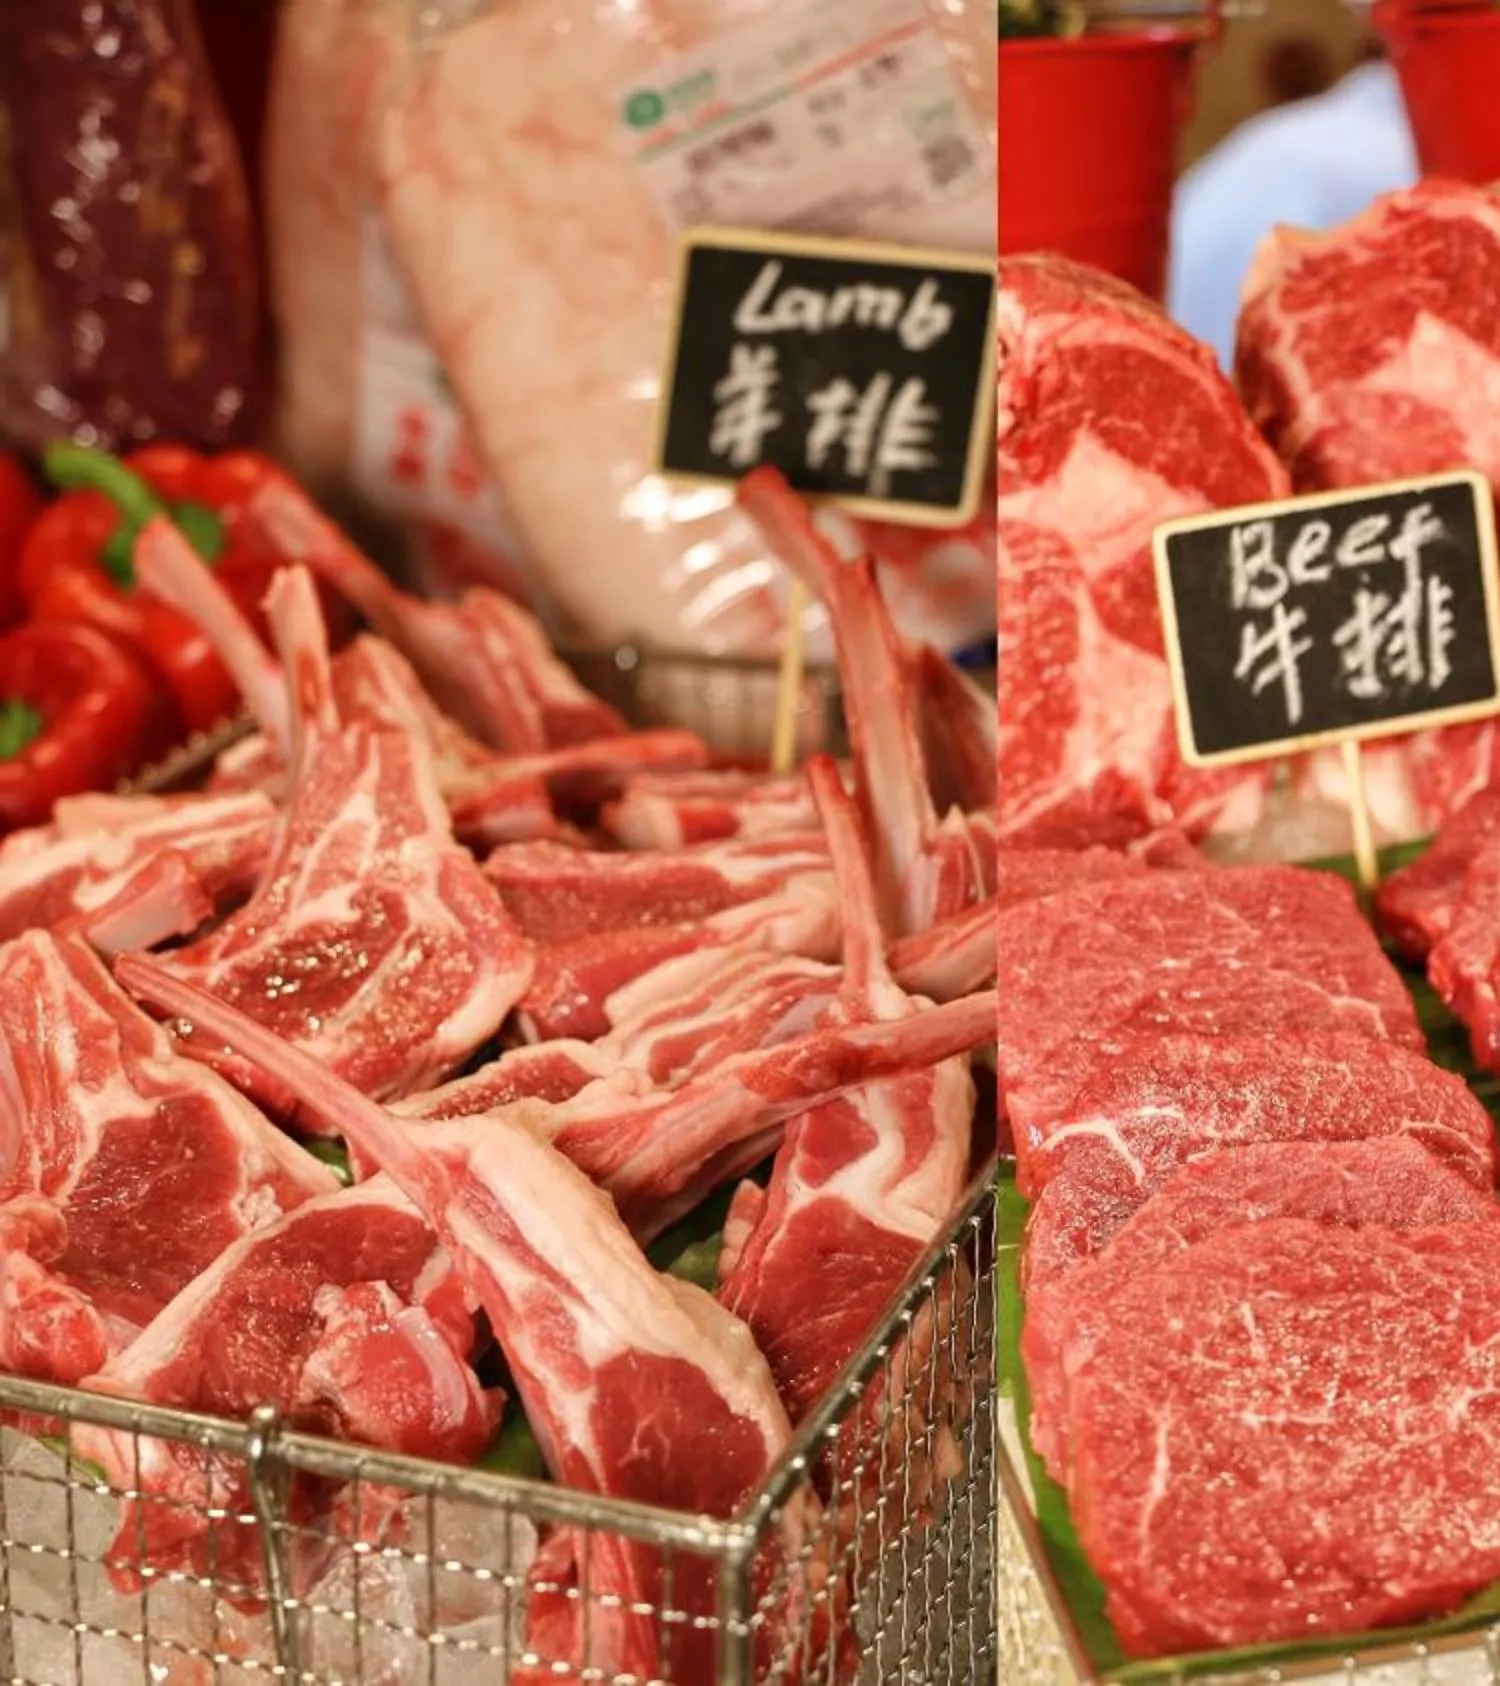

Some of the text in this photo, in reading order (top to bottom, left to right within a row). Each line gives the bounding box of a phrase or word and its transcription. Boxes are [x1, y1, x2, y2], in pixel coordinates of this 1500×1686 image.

[734, 260, 953, 351] Lamb
[709, 344, 938, 494] 羊排
[1230, 503, 1446, 609] Beef
[1233, 574, 1455, 724] 牛排
